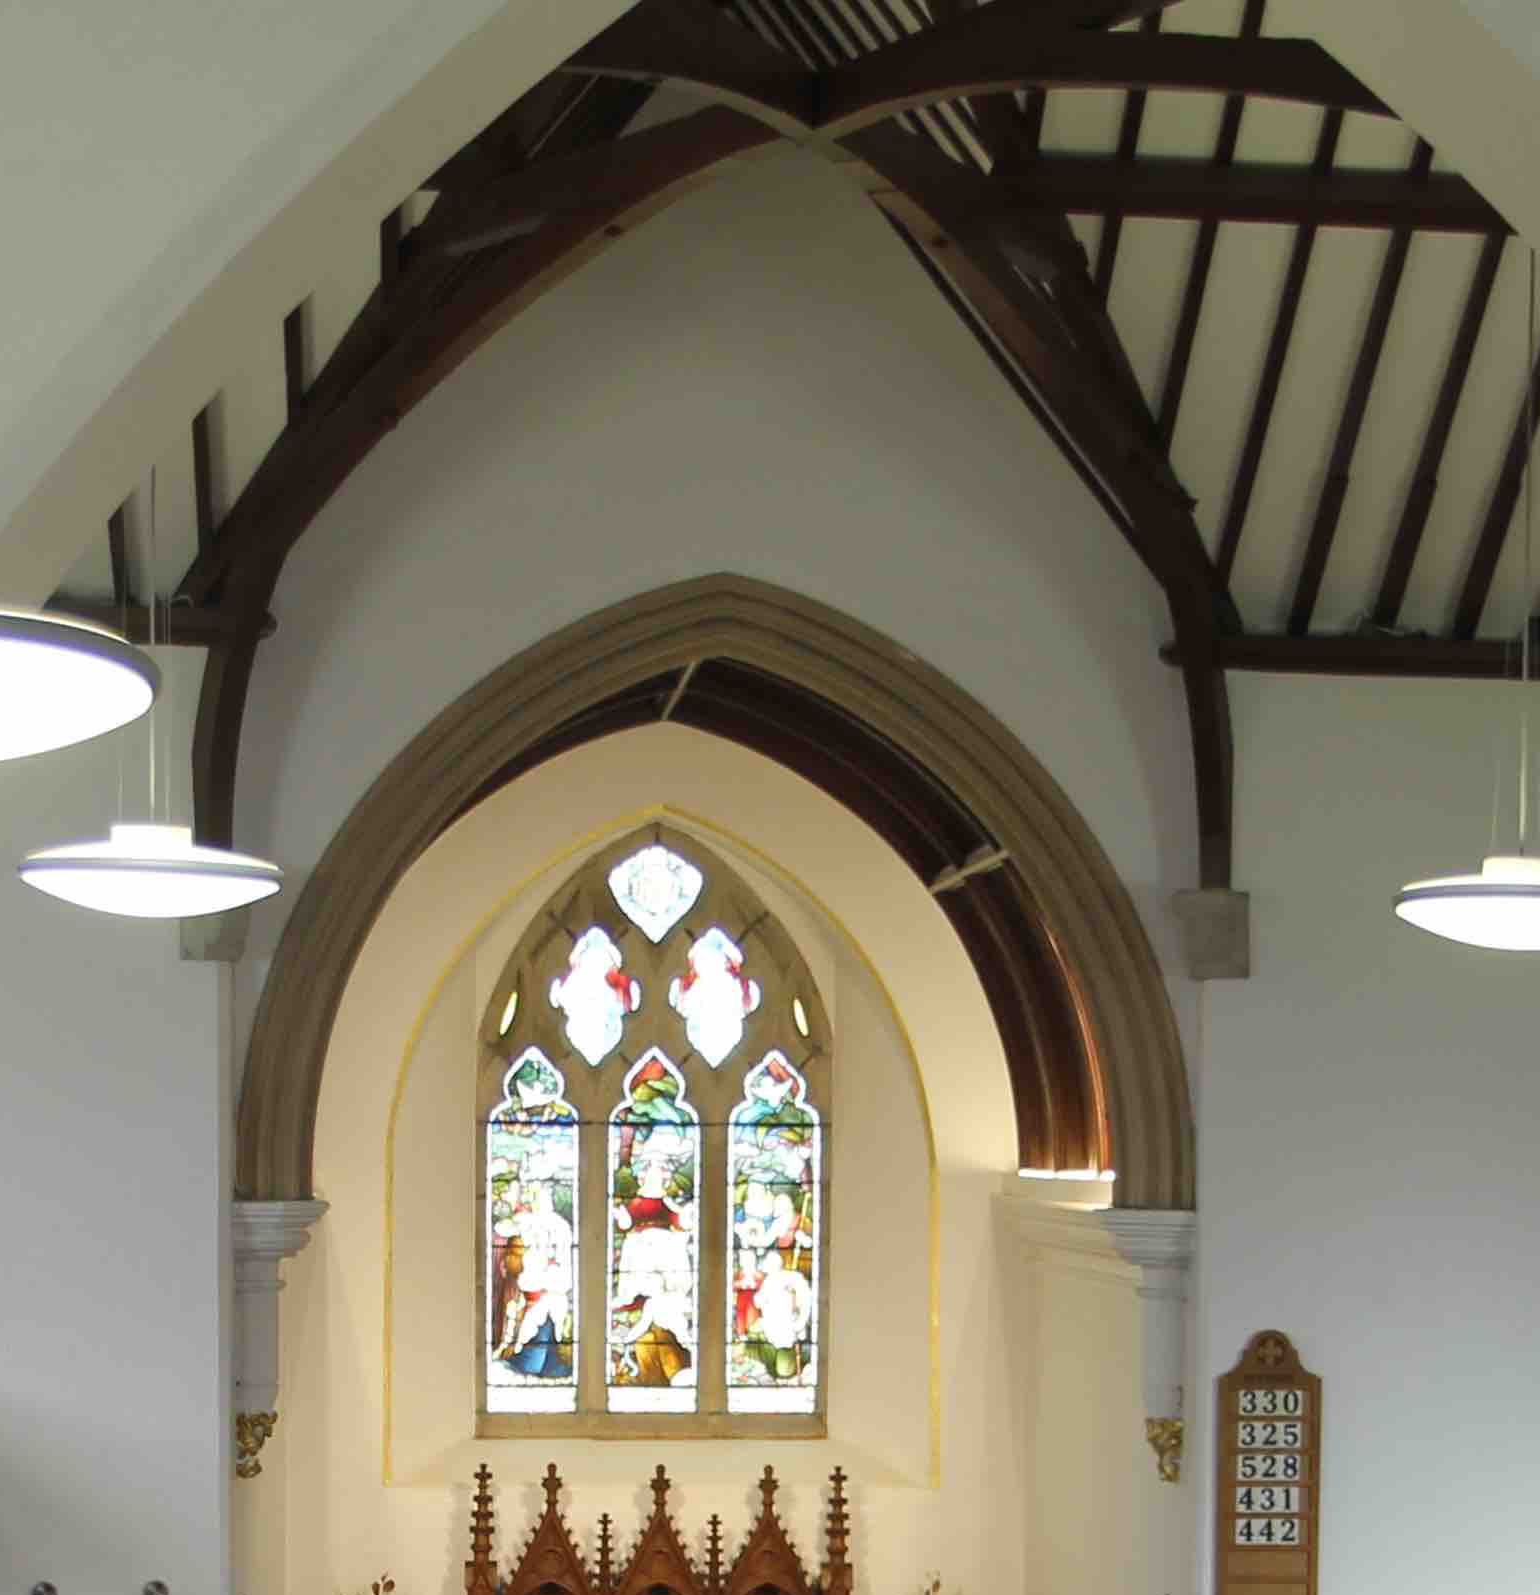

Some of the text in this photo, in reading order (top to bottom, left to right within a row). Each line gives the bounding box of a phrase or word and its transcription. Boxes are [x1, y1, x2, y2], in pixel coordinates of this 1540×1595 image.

[1241, 1390, 1299, 1414] 330
[1240, 1423, 1298, 1446] 325
[1240, 1455, 1298, 1479] 528
[1239, 1487, 1292, 1511] 431
[1238, 1518, 1297, 1542] 442
